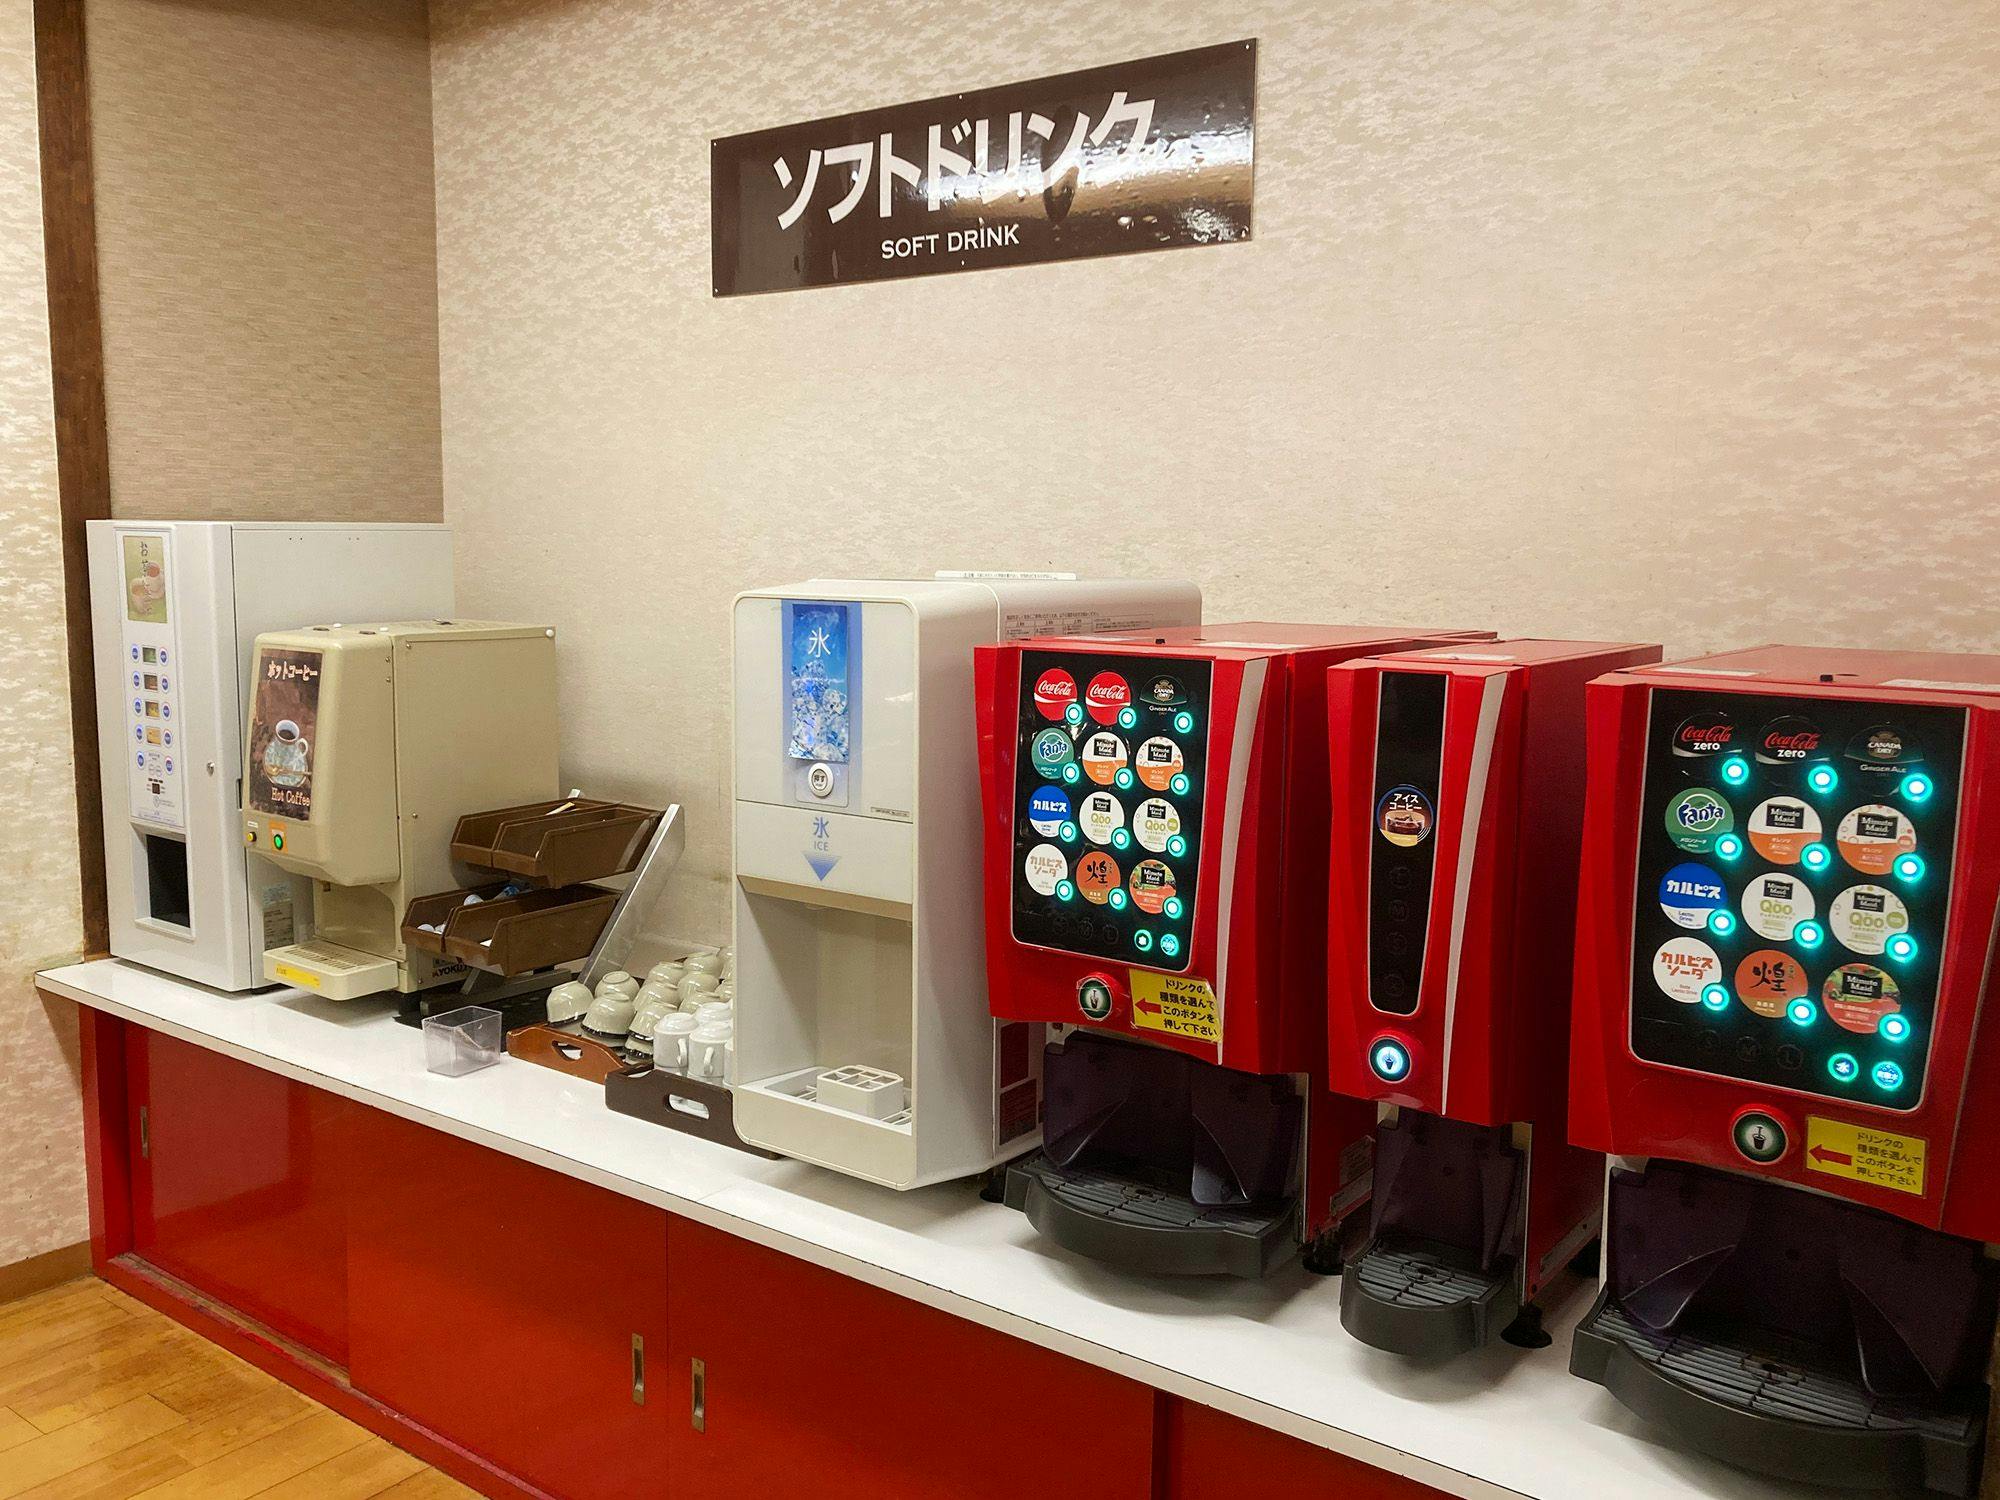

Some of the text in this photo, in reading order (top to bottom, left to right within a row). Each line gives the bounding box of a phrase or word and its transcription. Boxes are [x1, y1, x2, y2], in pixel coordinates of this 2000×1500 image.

[773, 91, 1156, 230] ソフトドリンク
[881, 224, 1020, 260] SOFT DRINK
[808, 627, 831, 657] 氷
[267, 660, 318, 681] ホットコーヒー
[1038, 680, 1073, 696] Coca-Cola
[1090, 684, 1127, 700] Coca-Cola
[1681, 725, 1734, 742] Coca-Cola
[1764, 732, 1821, 750] Coca-Cola
[1039, 740, 1069, 760] Fanta
[1693, 742, 1720, 751] zero
[1777, 749, 1806, 759] zero
[271, 787, 311, 807] Hot Coffee
[1393, 793, 1419, 804] アイス
[1033, 799, 1067, 813] カルピス
[1389, 801, 1422, 811] コーヒー
[1770, 808, 1800, 817] Minute
[1091, 813, 1111, 825] Qoo
[1676, 802, 1725, 828] Fanta
[1774, 815, 1796, 823] Maid
[1861, 816, 1894, 827] Minute
[813, 817, 829, 839] 氷
[1145, 819, 1166, 832] Qoo
[1865, 824, 1889, 833] Maid
[813, 841, 829, 852] ICE
[1030, 855, 1063, 869] カルピス
[1086, 860, 1108, 884] 煌
[1666, 879, 1721, 900] カルピス
[1760, 899, 1793, 915] Qoo
[1849, 911, 1885, 928] Qoo
[1661, 951, 1713, 970] カルピス
[1667, 964, 1707, 980] ソーダ
[1749, 961, 1788, 992] 煌
[1166, 979, 1206, 995] ドリンクの
[1846, 975, 1879, 987] Minute
[1850, 983, 1873, 992] Maid
[1163, 1006, 1215, 1024] このボタンを
[1163, 1018, 1219, 1036] 押して下さい
[1857, 1132, 1904, 1149] ドリンクの
[1856, 1156, 1914, 1176] このボタンを
[1856, 1167, 1917, 1186] 押して下さい
